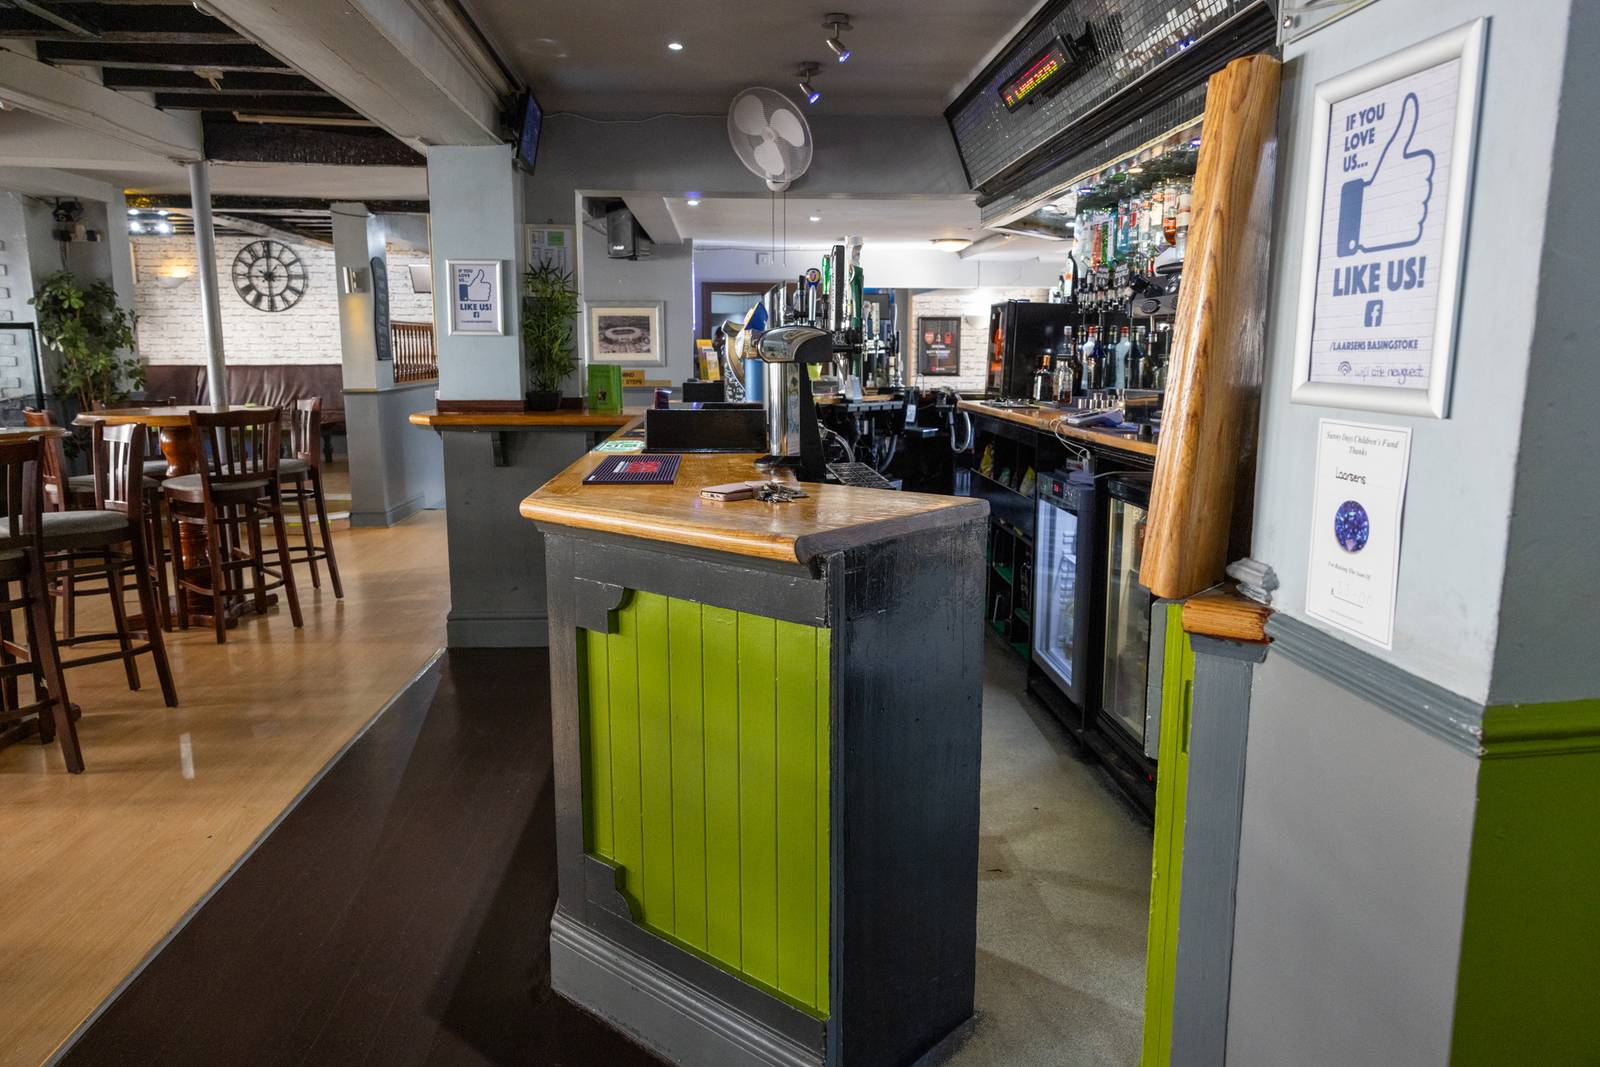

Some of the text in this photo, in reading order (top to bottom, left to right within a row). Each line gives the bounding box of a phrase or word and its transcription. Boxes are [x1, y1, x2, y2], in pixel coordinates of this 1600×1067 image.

[1346, 102, 1385, 132] IF YOU
[1344, 127, 1375, 152] LOVE
[1343, 153, 1368, 172] US...
[1333, 256, 1426, 297] LIKE US!
[479, 303, 492, 311] US!
[1367, 339, 1419, 351] BASINGSTOKE
[1354, 435, 1381, 447] Children's
[1382, 438, 1400, 449] Fund
[1349, 446, 1368, 456] Thanks
